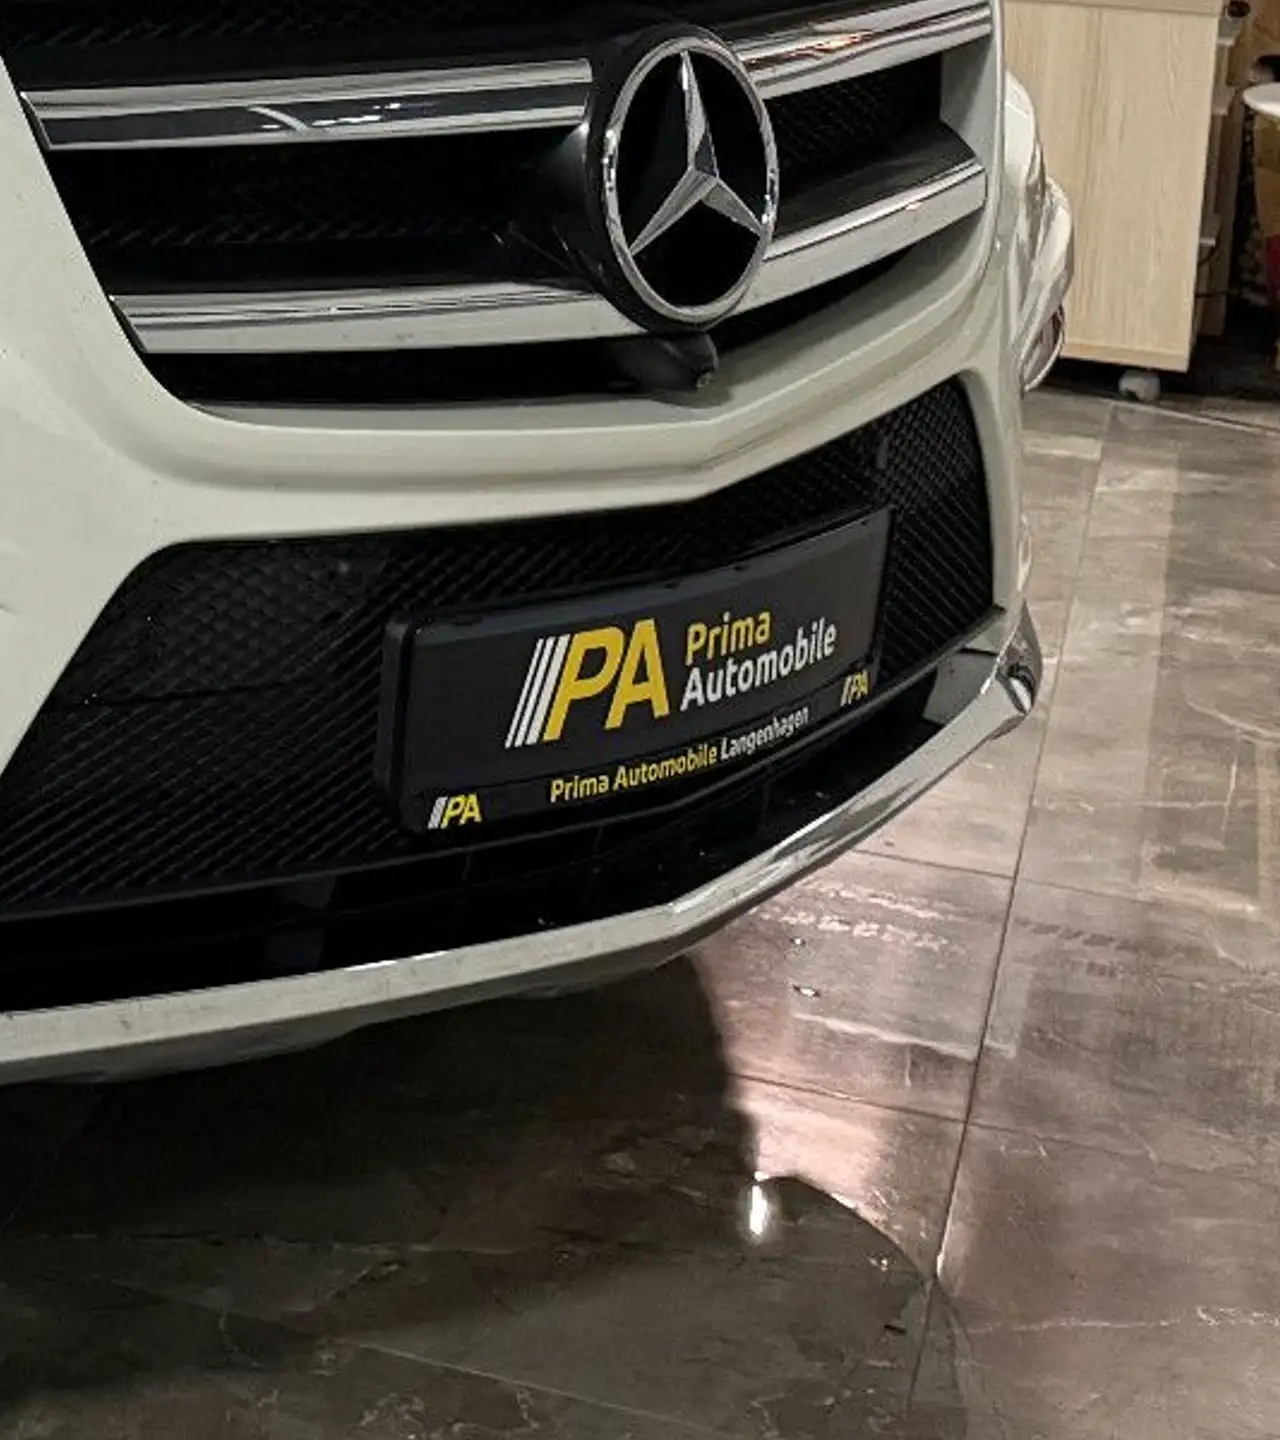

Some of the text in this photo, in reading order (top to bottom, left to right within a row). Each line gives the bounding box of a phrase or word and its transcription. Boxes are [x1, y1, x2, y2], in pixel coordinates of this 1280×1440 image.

[679, 616, 838, 712] Automobile
[685, 611, 771, 666] Prima
[550, 706, 810, 803] Prima Automobile Langenhagen
